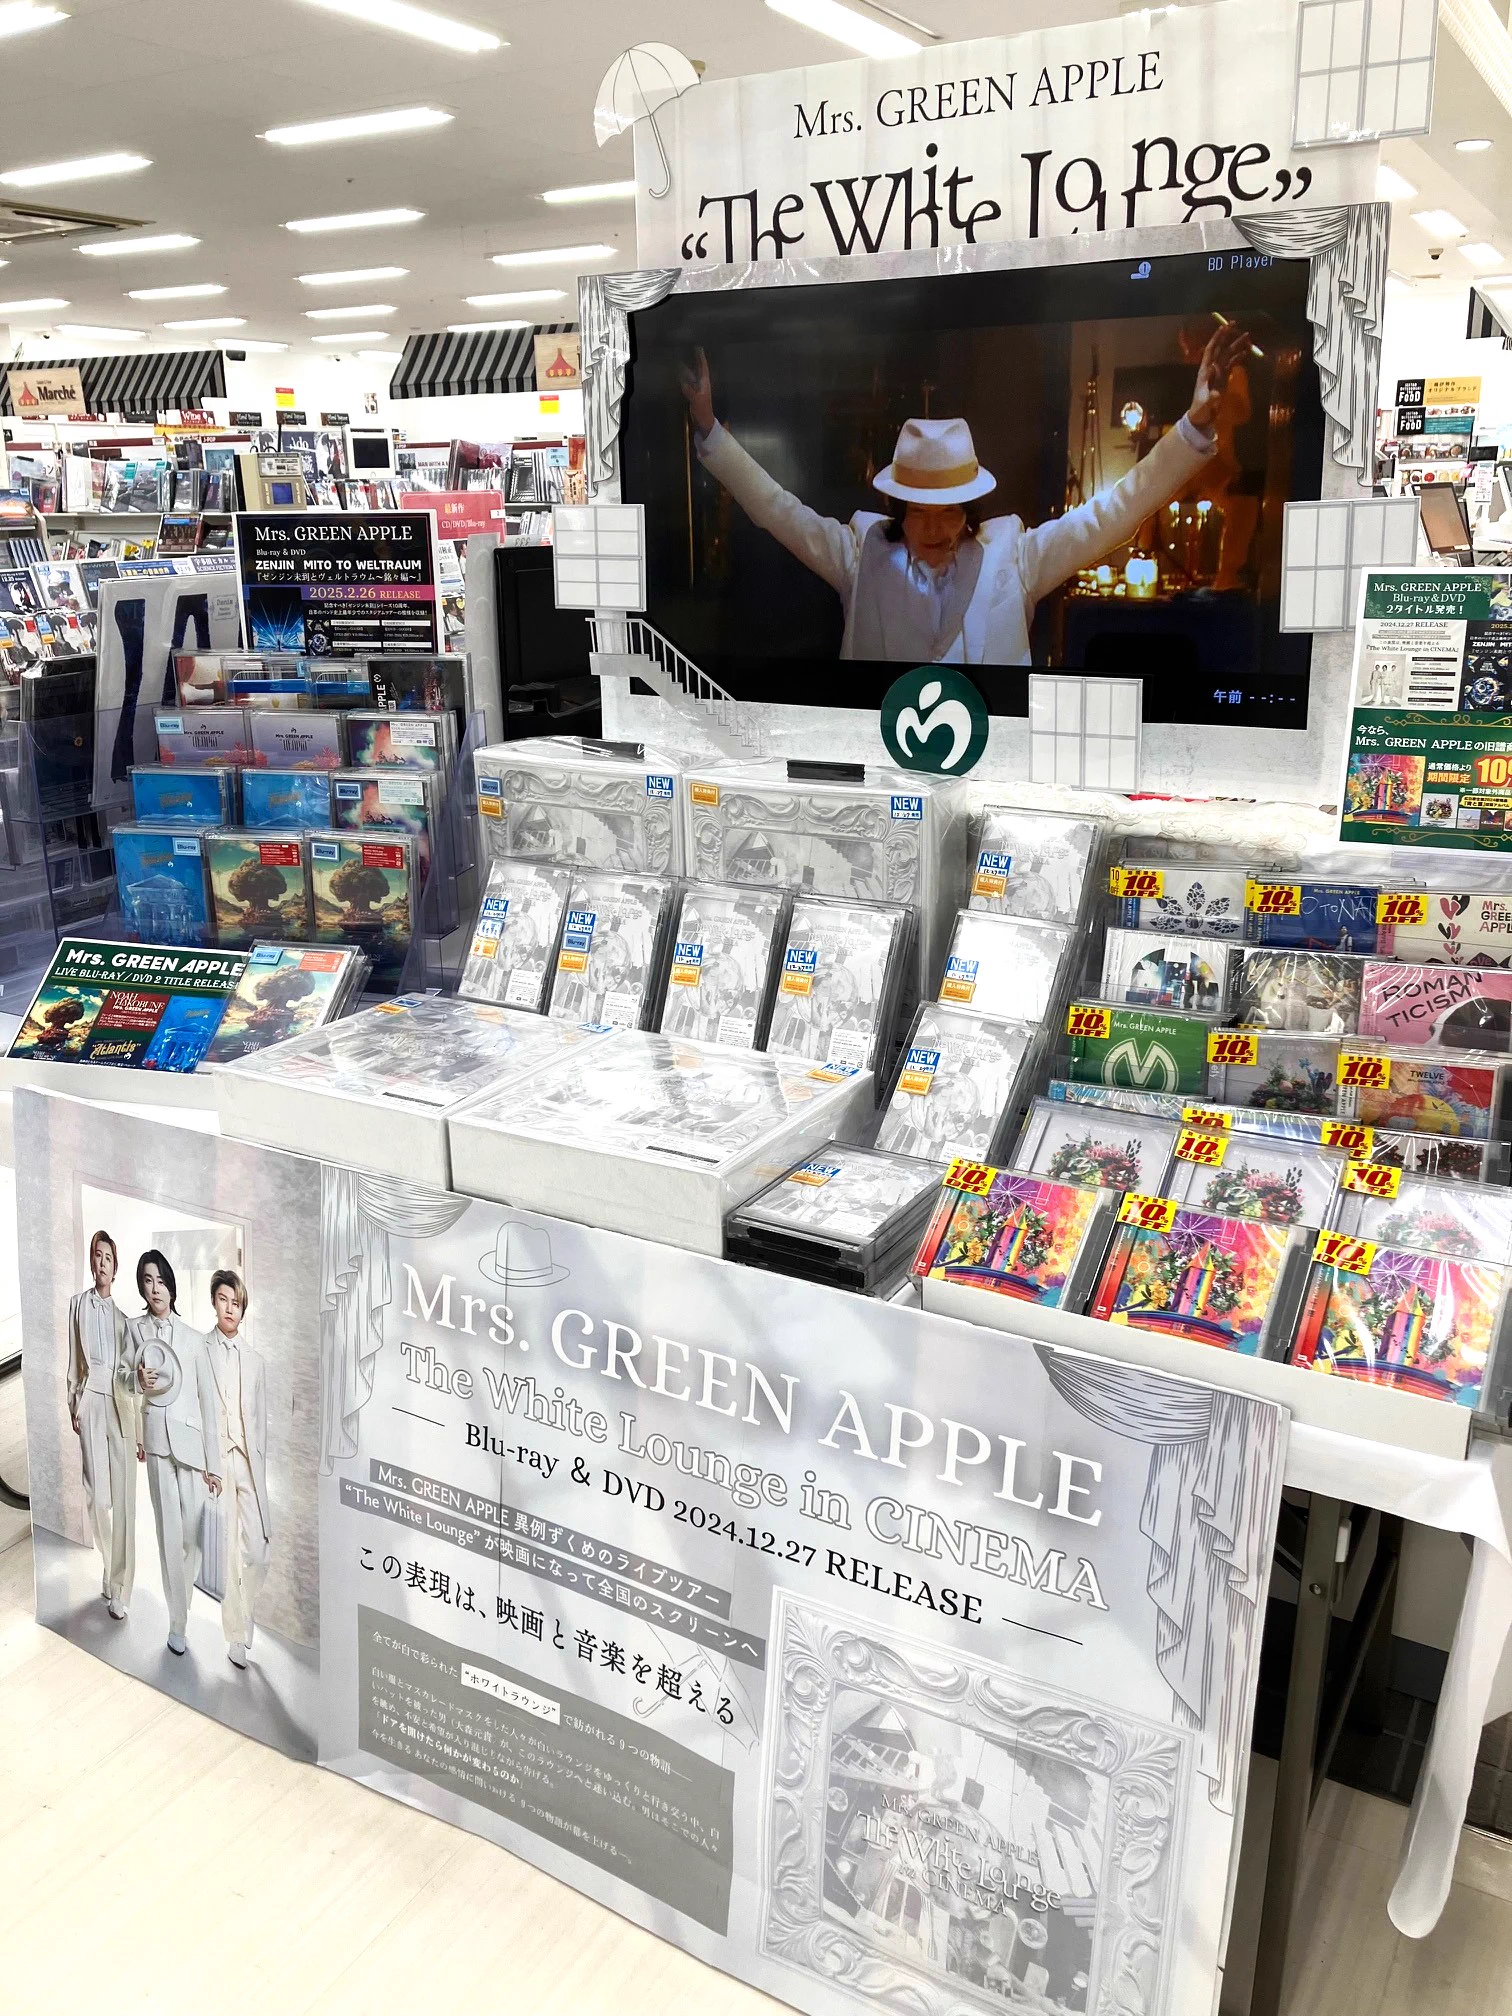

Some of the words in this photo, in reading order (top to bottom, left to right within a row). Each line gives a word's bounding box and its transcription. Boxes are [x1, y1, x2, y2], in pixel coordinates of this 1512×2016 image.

[793, 100, 862, 139] Mrs.
[876, 72, 1018, 127] GREEN
[1029, 51, 1164, 107] APPLE
[1207, 256, 1224, 272] BD
[1230, 254, 1276, 270] Player
[37, 384, 76, 401] Marché
[441, 519, 486, 529] CD/DVD/Blu-ray
[254, 526, 291, 541] Mrs.
[294, 525, 352, 541] GREEN
[357, 526, 413, 541] APPLE
[256, 549, 281, 558] Blu-ray
[255, 560, 295, 570] ZENJIN
[303, 560, 332, 570] MITO
[336, 560, 352, 570] TO
[355, 560, 422, 570] WELTRAUM
[309, 587, 376, 599] 2025.2.26
[380, 590, 421, 599] RELEASE
[1373, 582, 1398, 592] Mrs.
[1400, 583, 1441, 592] GREEN
[1443, 583, 1482, 592] APPLE
[1400, 646, 1422, 654] Lounge
[1213, 689, 1243, 704] 午前
[159, 722, 180, 730] Blu-ray
[1355, 735, 1380, 747] Mrs.
[1385, 737, 1427, 749] GREEN
[1427, 762, 1472, 772] 通常価格より
[1477, 758, 1512, 784] 10
[648, 776, 671, 790] NEW
[1426, 772, 1471, 784] 期間限定
[893, 797, 919, 811] NEW
[983, 854, 1009, 869] NEW
[1123, 875, 1160, 891] 10%
[486, 899, 506, 911] NEW
[1258, 890, 1297, 907] 10%
[1482, 900, 1508, 912] Mrs.
[1256, 906, 1296, 914] OFF
[1384, 900, 1424, 917] 10%
[1481, 910, 1512, 922] GREE
[571, 912, 594, 925] NEW
[1381, 915, 1424, 924] OFF
[1479, 922, 1512, 934] APPL
[678, 944, 701, 957] NEW
[790, 950, 815, 963] NEW
[65, 948, 106, 966] Mrs.
[111, 953, 180, 973] GREEN
[178, 957, 247, 977] APPLE
[950, 959, 977, 972] NEW
[55, 967, 80, 977] LIVE
[78, 969, 124, 981] BLU-RAY
[132, 973, 153, 983] DVD
[154, 975, 161, 984] 2
[164, 976, 192, 986] TITLE
[193, 977, 238, 989] RELEAS
[1382, 971, 1483, 1003] ROMAN
[1385, 984, 1473, 1028] TICISM
[1070, 1013, 1107, 1031] 10%
[1113, 1021, 1128, 1029] Mrs.
[1129, 1022, 1155, 1033] GREEN
[1155, 1026, 1177, 1036] APPLE
[1069, 1029, 1107, 1037] OFF
[1213, 1039, 1254, 1057] 10%
[910, 1051, 937, 1065] NEW
[1211, 1055, 1253, 1064] OFF
[1343, 1062, 1387, 1080] 10%
[1410, 1070, 1445, 1080] TWELVE
[1341, 1078, 1386, 1088] OFF
[1181, 1136, 1220, 1158] 10%
[806, 1163, 836, 1173] NEW
[950, 1164, 989, 1188] 10%
[1352, 1168, 1395, 1190] 10%
[945, 1177, 985, 1194] OFF
[1347, 1182, 1394, 1196] OFF
[1321, 1237, 1368, 1266] 10%
[402, 1261, 530, 1352] Mrs.
[550, 1308, 801, 1435] GREEN
[817, 1389, 1104, 1527] APPLE
[400, 1341, 474, 1400] The
[483, 1366, 608, 1444] White
[617, 1412, 788, 1509] Lounge
[800, 1470, 853, 1531] in
[864, 1496, 1110, 1612] CINEMA
[465, 1422, 560, 1480] Blu-ray
[570, 1456, 593, 1487] &
[602, 1470, 666, 1513] DVD
[674, 1499, 817, 1568] 2024.12.27
[824, 1549, 984, 1625] RELEASE
[378, 1464, 407, 1490] Mrs.
[411, 1477, 461, 1509] GREEN
[464, 1497, 510, 1527] APPLE
[514, 1512, 720, 1604] 異例ずくめのライブツアー
[345, 1484, 380, 1509] “The
[383, 1496, 422, 1524] White
[426, 1512, 481, 1547] Lounge”
[484, 1534, 759, 1657] が映画になって全国のスクリーンへ
[358, 1546, 735, 1726] この表現は、映画と音楽を超える
[372, 1630, 459, 1678] 全てが白で彩られた
[881, 1793, 912, 1819] Mrs.
[917, 1809, 981, 1844] GREEN
[984, 1833, 1040, 1868] APPLE
[856, 1810, 898, 1850] The
[901, 1826, 973, 1881] White
[976, 1855, 1062, 1913] Lounge
[921, 1869, 1008, 1917] CINEMA
